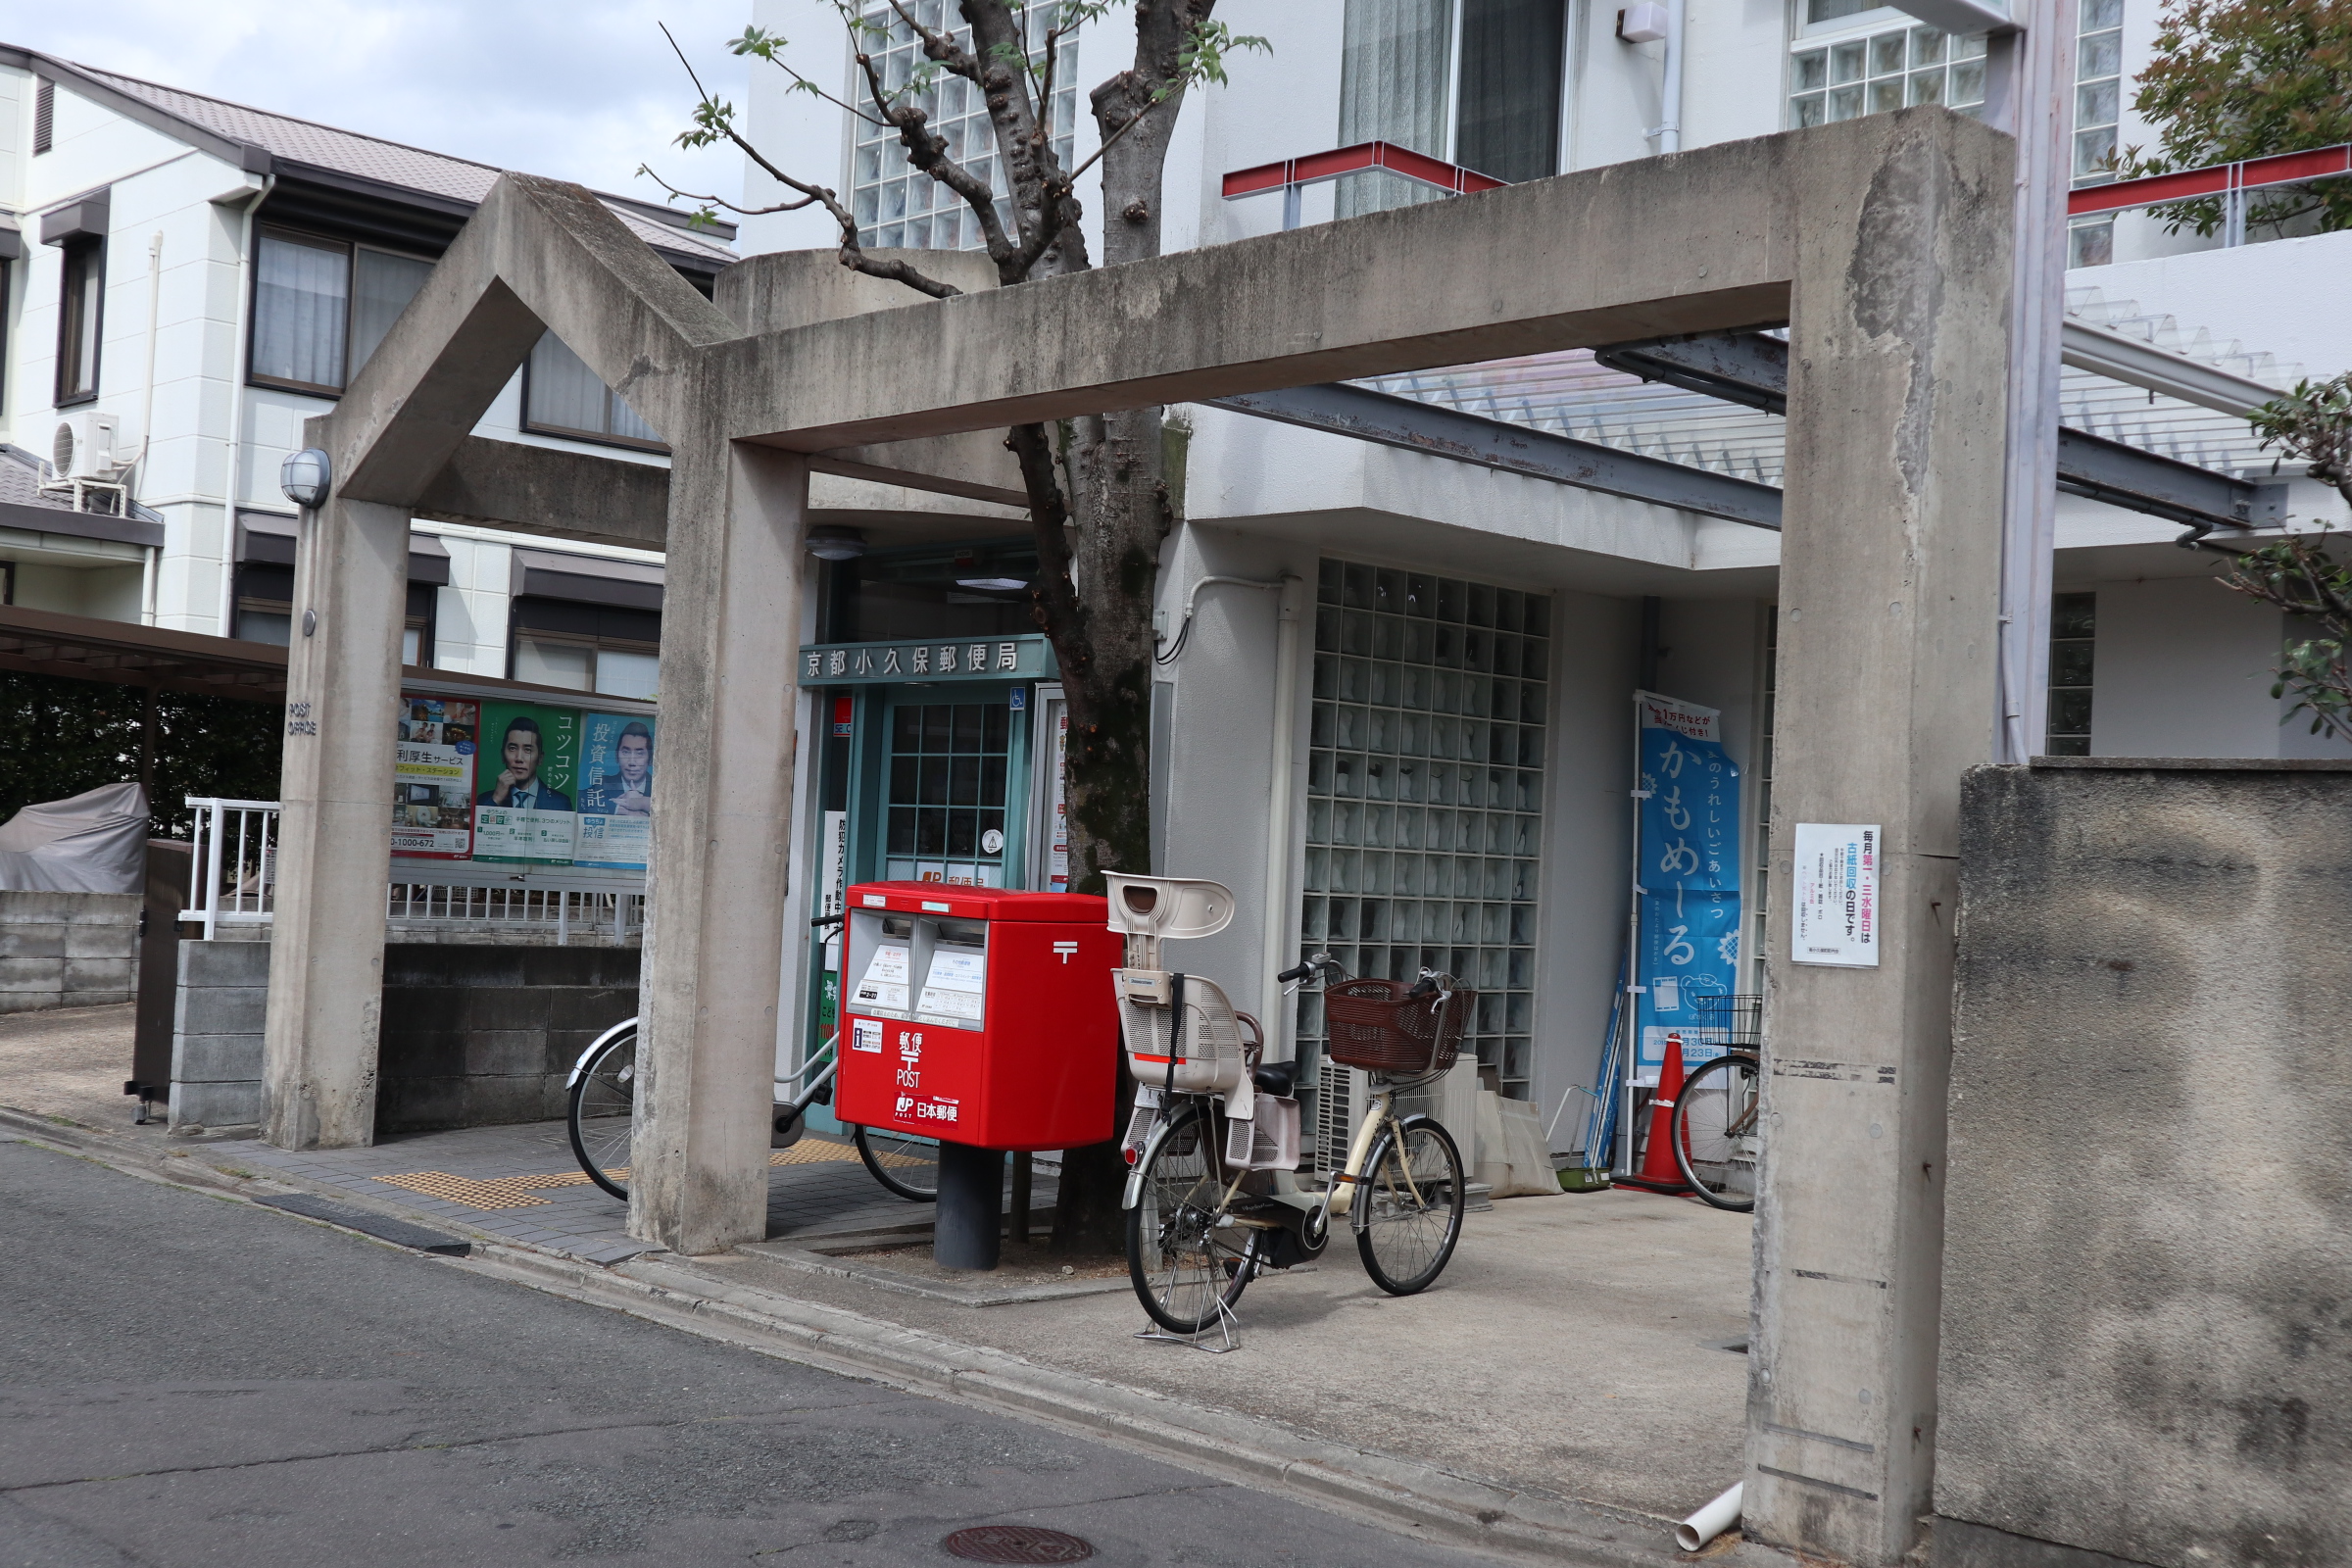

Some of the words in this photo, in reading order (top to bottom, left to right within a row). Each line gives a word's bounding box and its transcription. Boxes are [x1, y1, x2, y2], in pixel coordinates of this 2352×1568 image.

[807, 642, 1018, 677] 京都小久保郵便局
[290, 703, 311, 716] POST
[288, 721, 314, 736] OFFICE
[397, 749, 464, 765] 利厚生サービス
[554, 715, 572, 790] コツコツ
[586, 722, 611, 808] 投資信託
[583, 826, 605, 839] 投信
[1659, 740, 1702, 966] かもめーる
[833, 819, 846, 937] 防犯カメラ作動中す
[1844, 842, 1858, 942] 古紙回収の日です。
[1861, 830, 1874, 944] 毎月第一・三水曜日は
[899, 1031, 923, 1054] 郵便
[896, 1068, 921, 1089] POST
[896, 1096, 914, 1112] JP
[916, 1102, 957, 1122] 日本郵便
